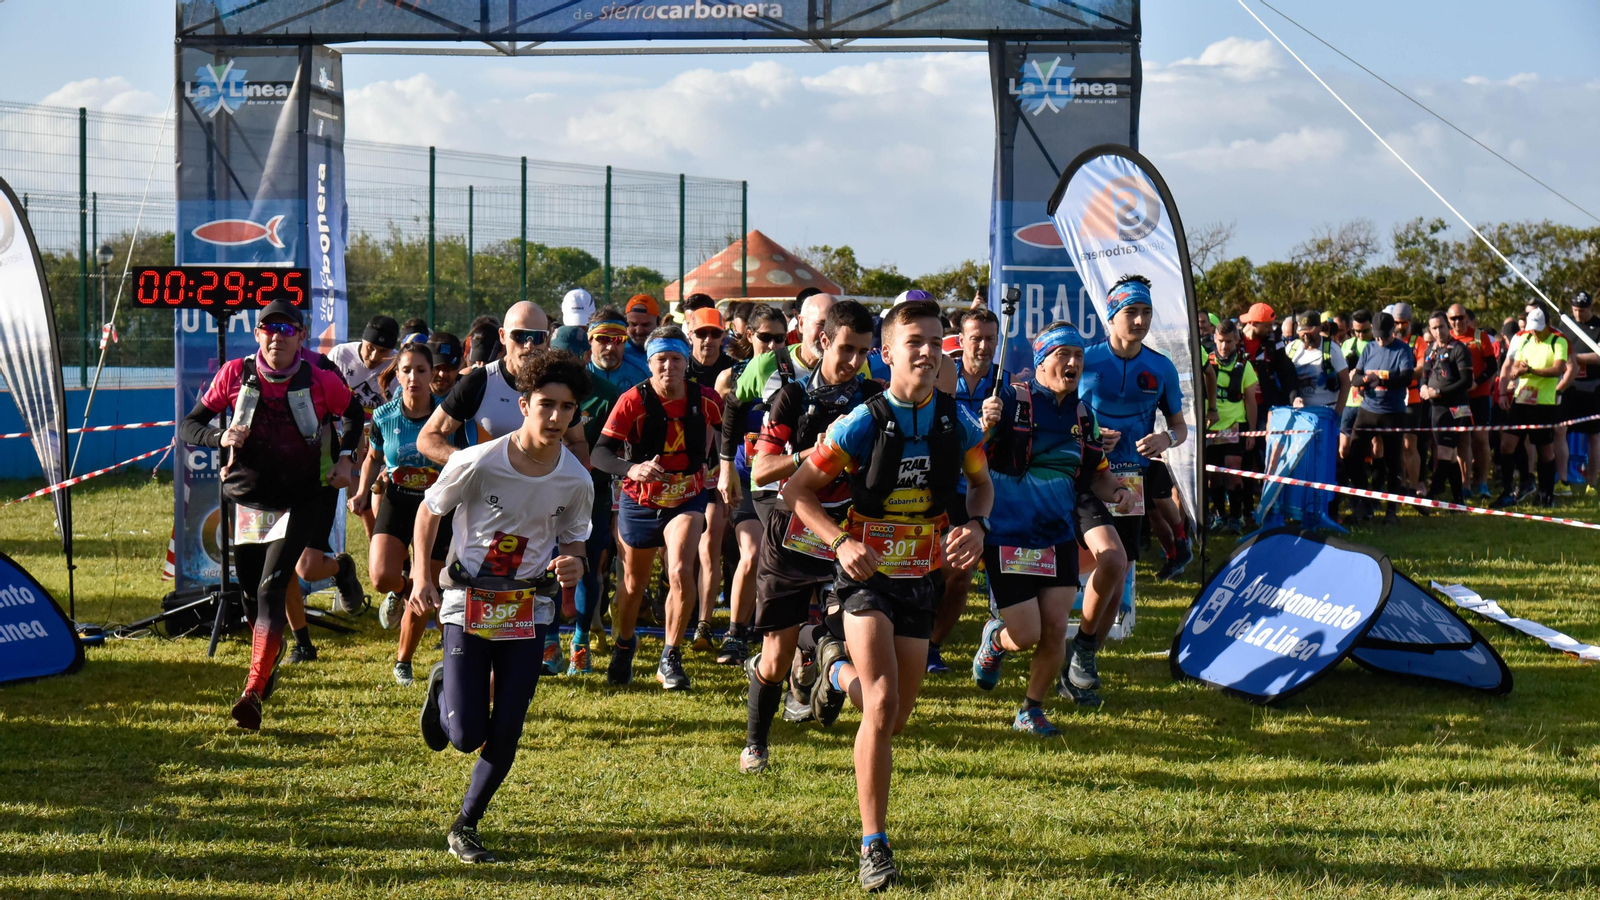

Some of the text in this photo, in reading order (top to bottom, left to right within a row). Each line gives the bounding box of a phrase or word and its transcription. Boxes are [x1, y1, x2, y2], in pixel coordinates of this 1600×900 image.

[573, 9, 593, 20] de
[185, 81, 210, 97] La
[1008, 78, 1035, 95] La
[317, 163, 335, 322] carbonera
[137, 270, 303, 306] 00:29:25
[403, 474, 428, 484] 484
[661, 483, 687, 495] 285
[249, 512, 276, 525] 310
[882, 540, 917, 556] 301
[1014, 547, 1042, 560] 475
[1239, 572, 1362, 630] Ayuntamiento
[483, 603, 519, 620] 356
[1225, 613, 1320, 662] de La Línea
